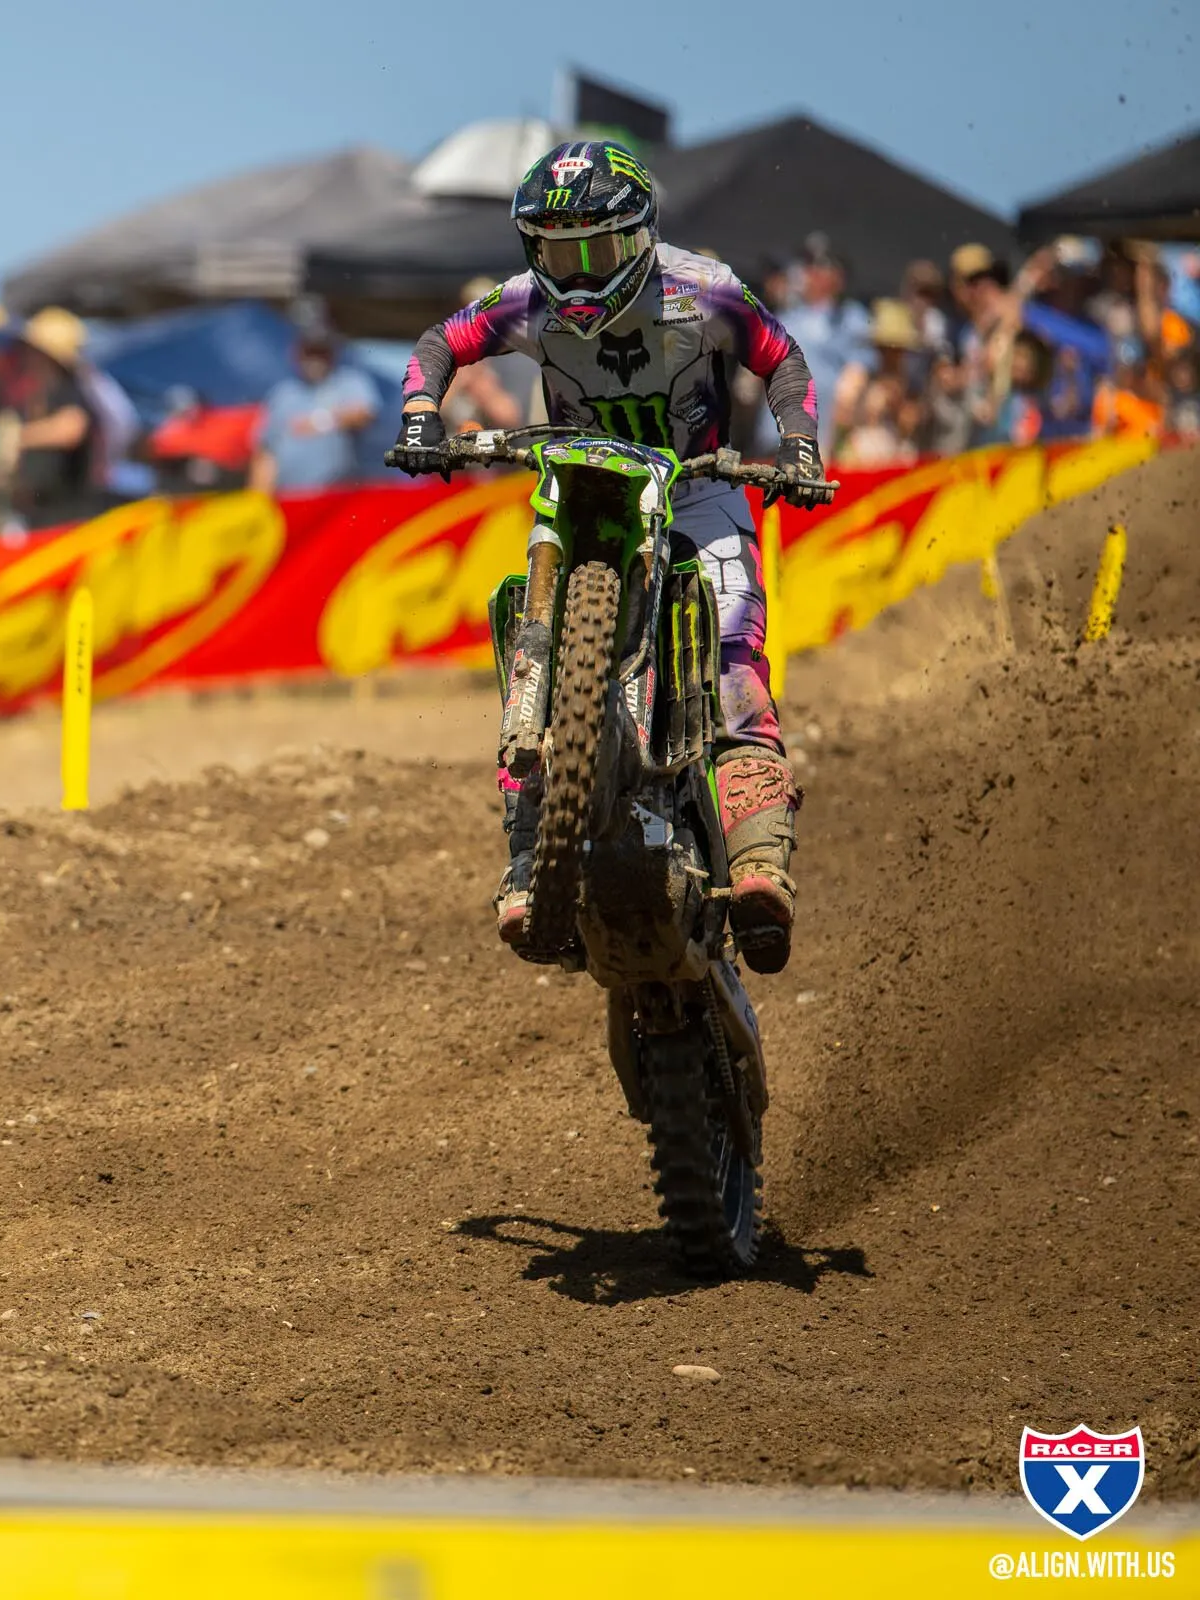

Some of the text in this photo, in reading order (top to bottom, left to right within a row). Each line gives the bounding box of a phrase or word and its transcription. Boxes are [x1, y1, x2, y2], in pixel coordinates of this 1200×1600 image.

[558, 161, 586, 169] BELL
[663, 295, 697, 312] SMX
[653, 313, 704, 327] Kawasaki
[406, 415, 426, 447] FOX
[798, 438, 814, 479] FOX
